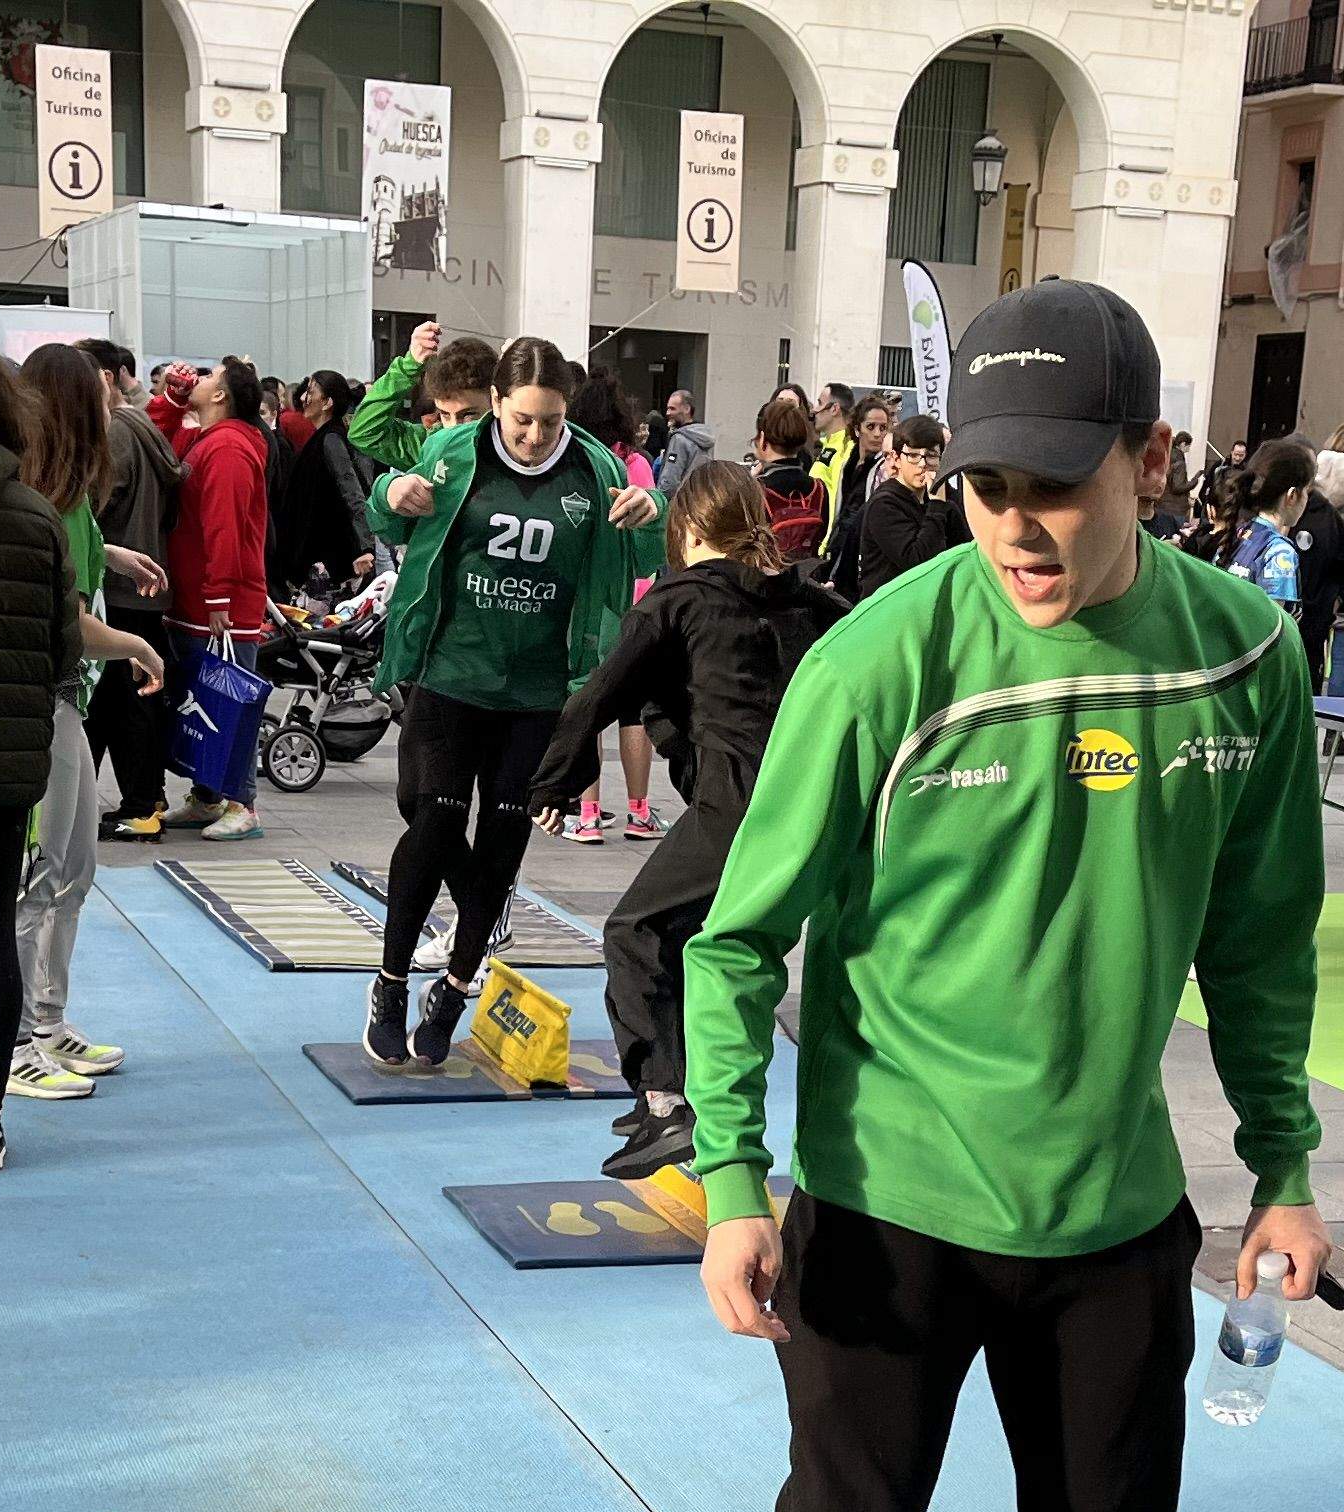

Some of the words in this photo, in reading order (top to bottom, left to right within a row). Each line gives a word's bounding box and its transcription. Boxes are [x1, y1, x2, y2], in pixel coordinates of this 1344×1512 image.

[51, 66, 101, 82] Oficina
[84, 87, 102, 100] de
[45, 100, 102, 117] Turismo
[402, 121, 442, 143] HUESCA
[694, 129, 736, 144] Oficina
[721, 148, 736, 160] de
[687, 161, 736, 176] Turismo
[968, 347, 1066, 374] Champion
[487, 512, 554, 563] 20
